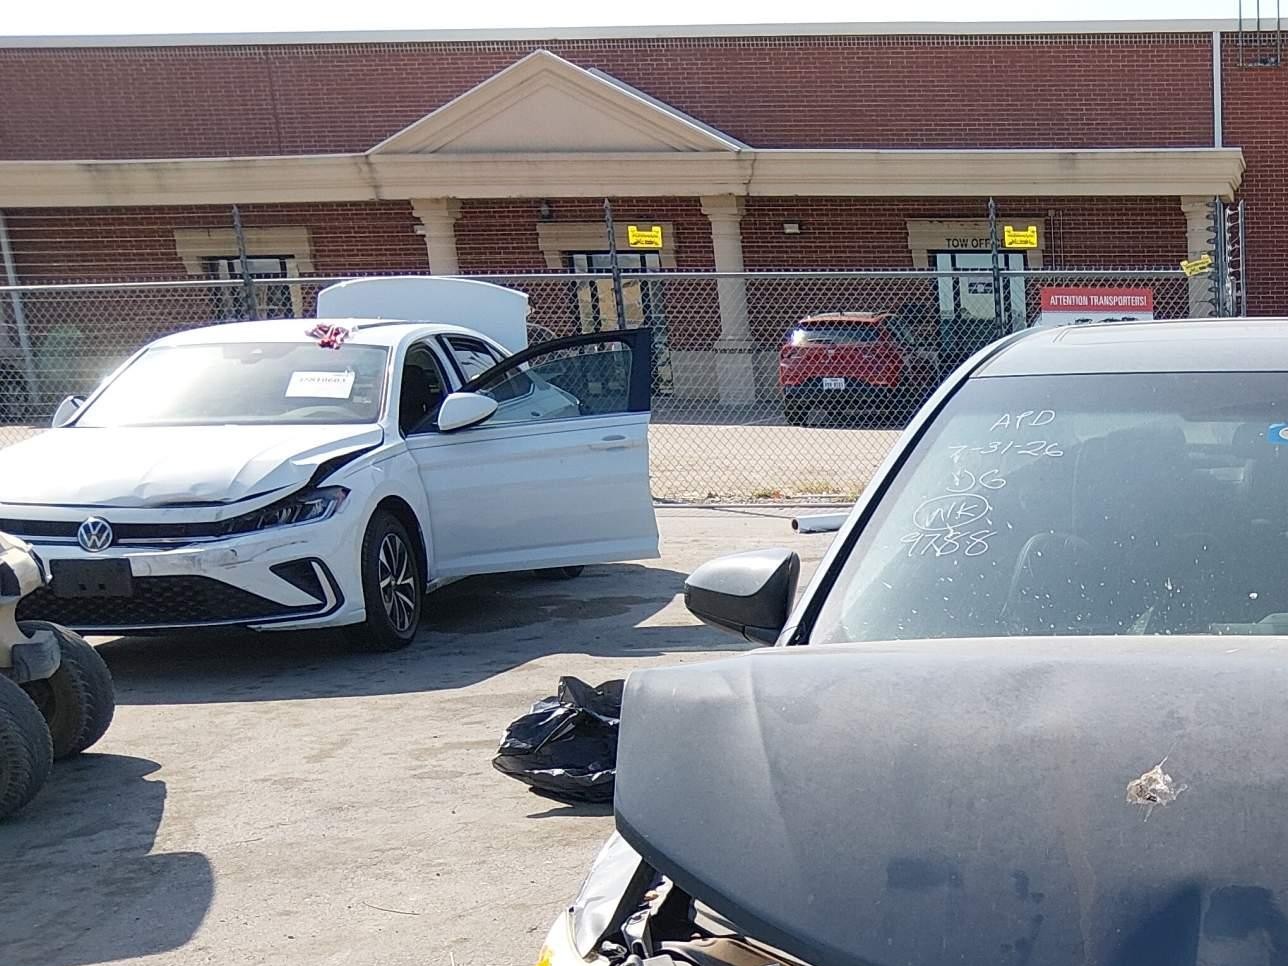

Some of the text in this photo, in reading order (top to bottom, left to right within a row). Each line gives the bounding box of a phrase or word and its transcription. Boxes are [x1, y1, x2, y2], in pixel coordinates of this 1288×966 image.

[945, 239, 969, 249] TOW
[1050, 295, 1148, 306] ATTENTION TRANSPORTERS!
[990, 409, 1056, 432] APD
[949, 440, 1064, 462] 7-31-26
